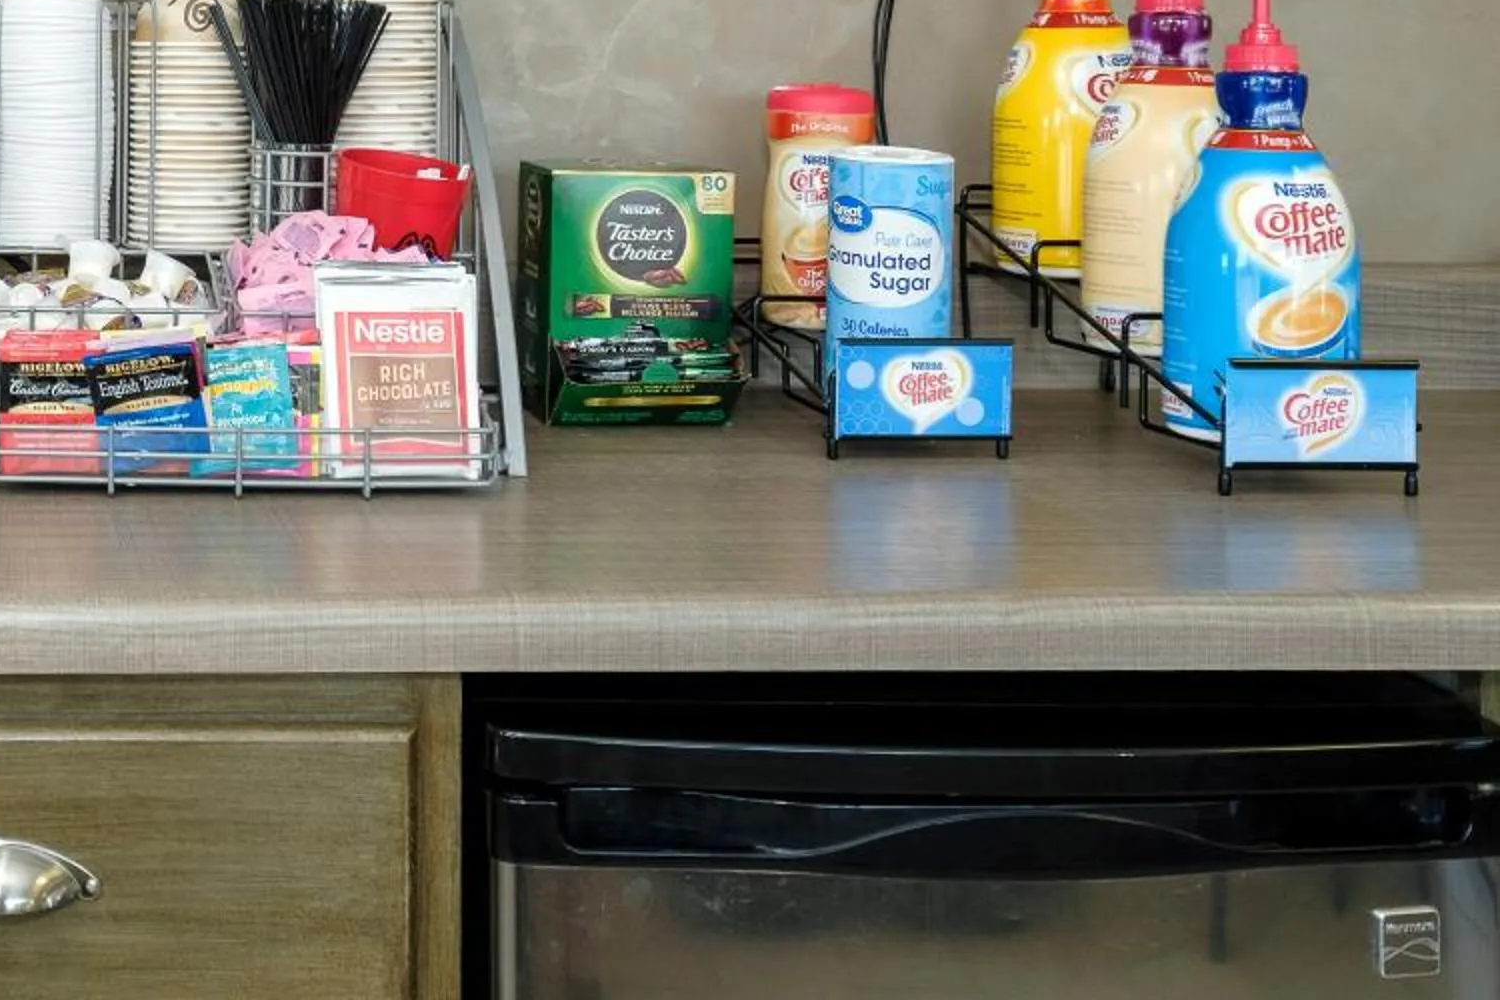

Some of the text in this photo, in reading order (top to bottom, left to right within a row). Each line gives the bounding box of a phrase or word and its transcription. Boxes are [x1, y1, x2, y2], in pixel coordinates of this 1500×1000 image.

[702, 175, 727, 192] 80
[608, 242, 675, 262] Choice
[1283, 225, 1347, 257] mate
[829, 245, 931, 271] Granulated
[869, 272, 932, 295] Sugar
[380, 362, 426, 384] RICH
[357, 380, 452, 402] CHOCOLATE
